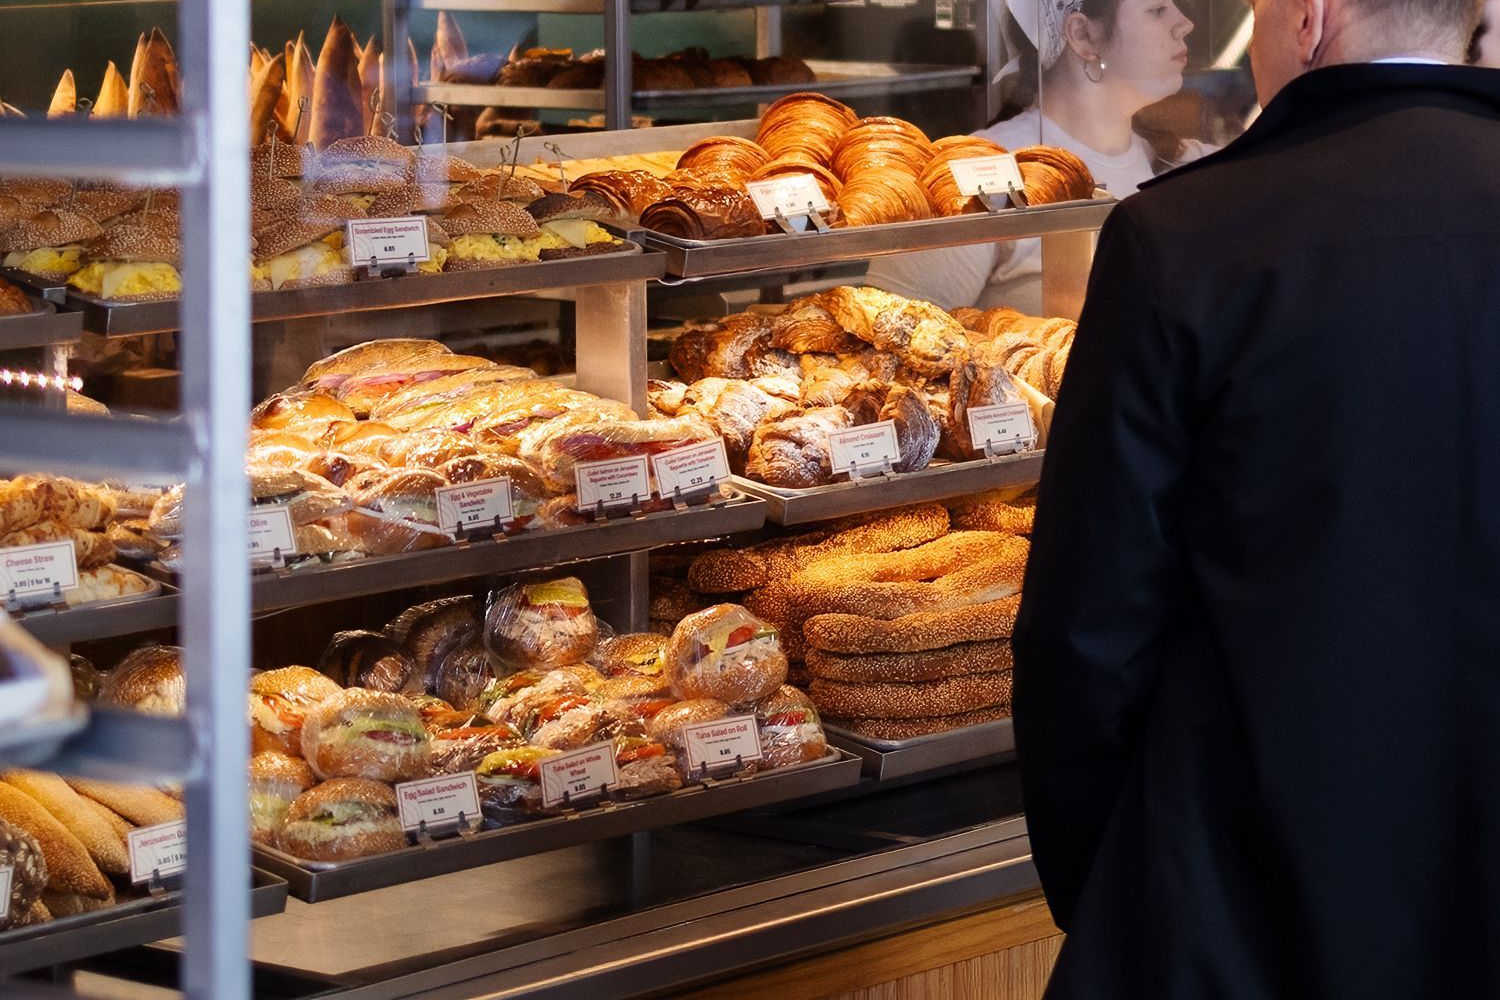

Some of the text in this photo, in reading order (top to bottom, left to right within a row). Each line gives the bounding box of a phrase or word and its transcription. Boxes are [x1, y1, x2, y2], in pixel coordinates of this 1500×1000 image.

[384, 226, 394, 235] Egg
[394, 225, 420, 233] Sandwich
[839, 434, 859, 445] Almond
[860, 430, 885, 440] Croissant
[450, 493, 461, 501] Egg
[466, 487, 493, 498] Vegetable
[459, 498, 485, 508] Sandwich
[250, 519, 268, 528] Olive
[6, 555, 55, 568] Cheese Straw
[696, 731, 711, 740] Tuna
[711, 727, 727, 737] Salad
[736, 724, 748, 733] Roll
[570, 767, 586, 777] Wheat
[404, 789, 417, 800] Egg
[418, 786, 435, 798] Salad
[436, 781, 467, 794] Sandwich
[139, 833, 177, 848] Jerusalem
